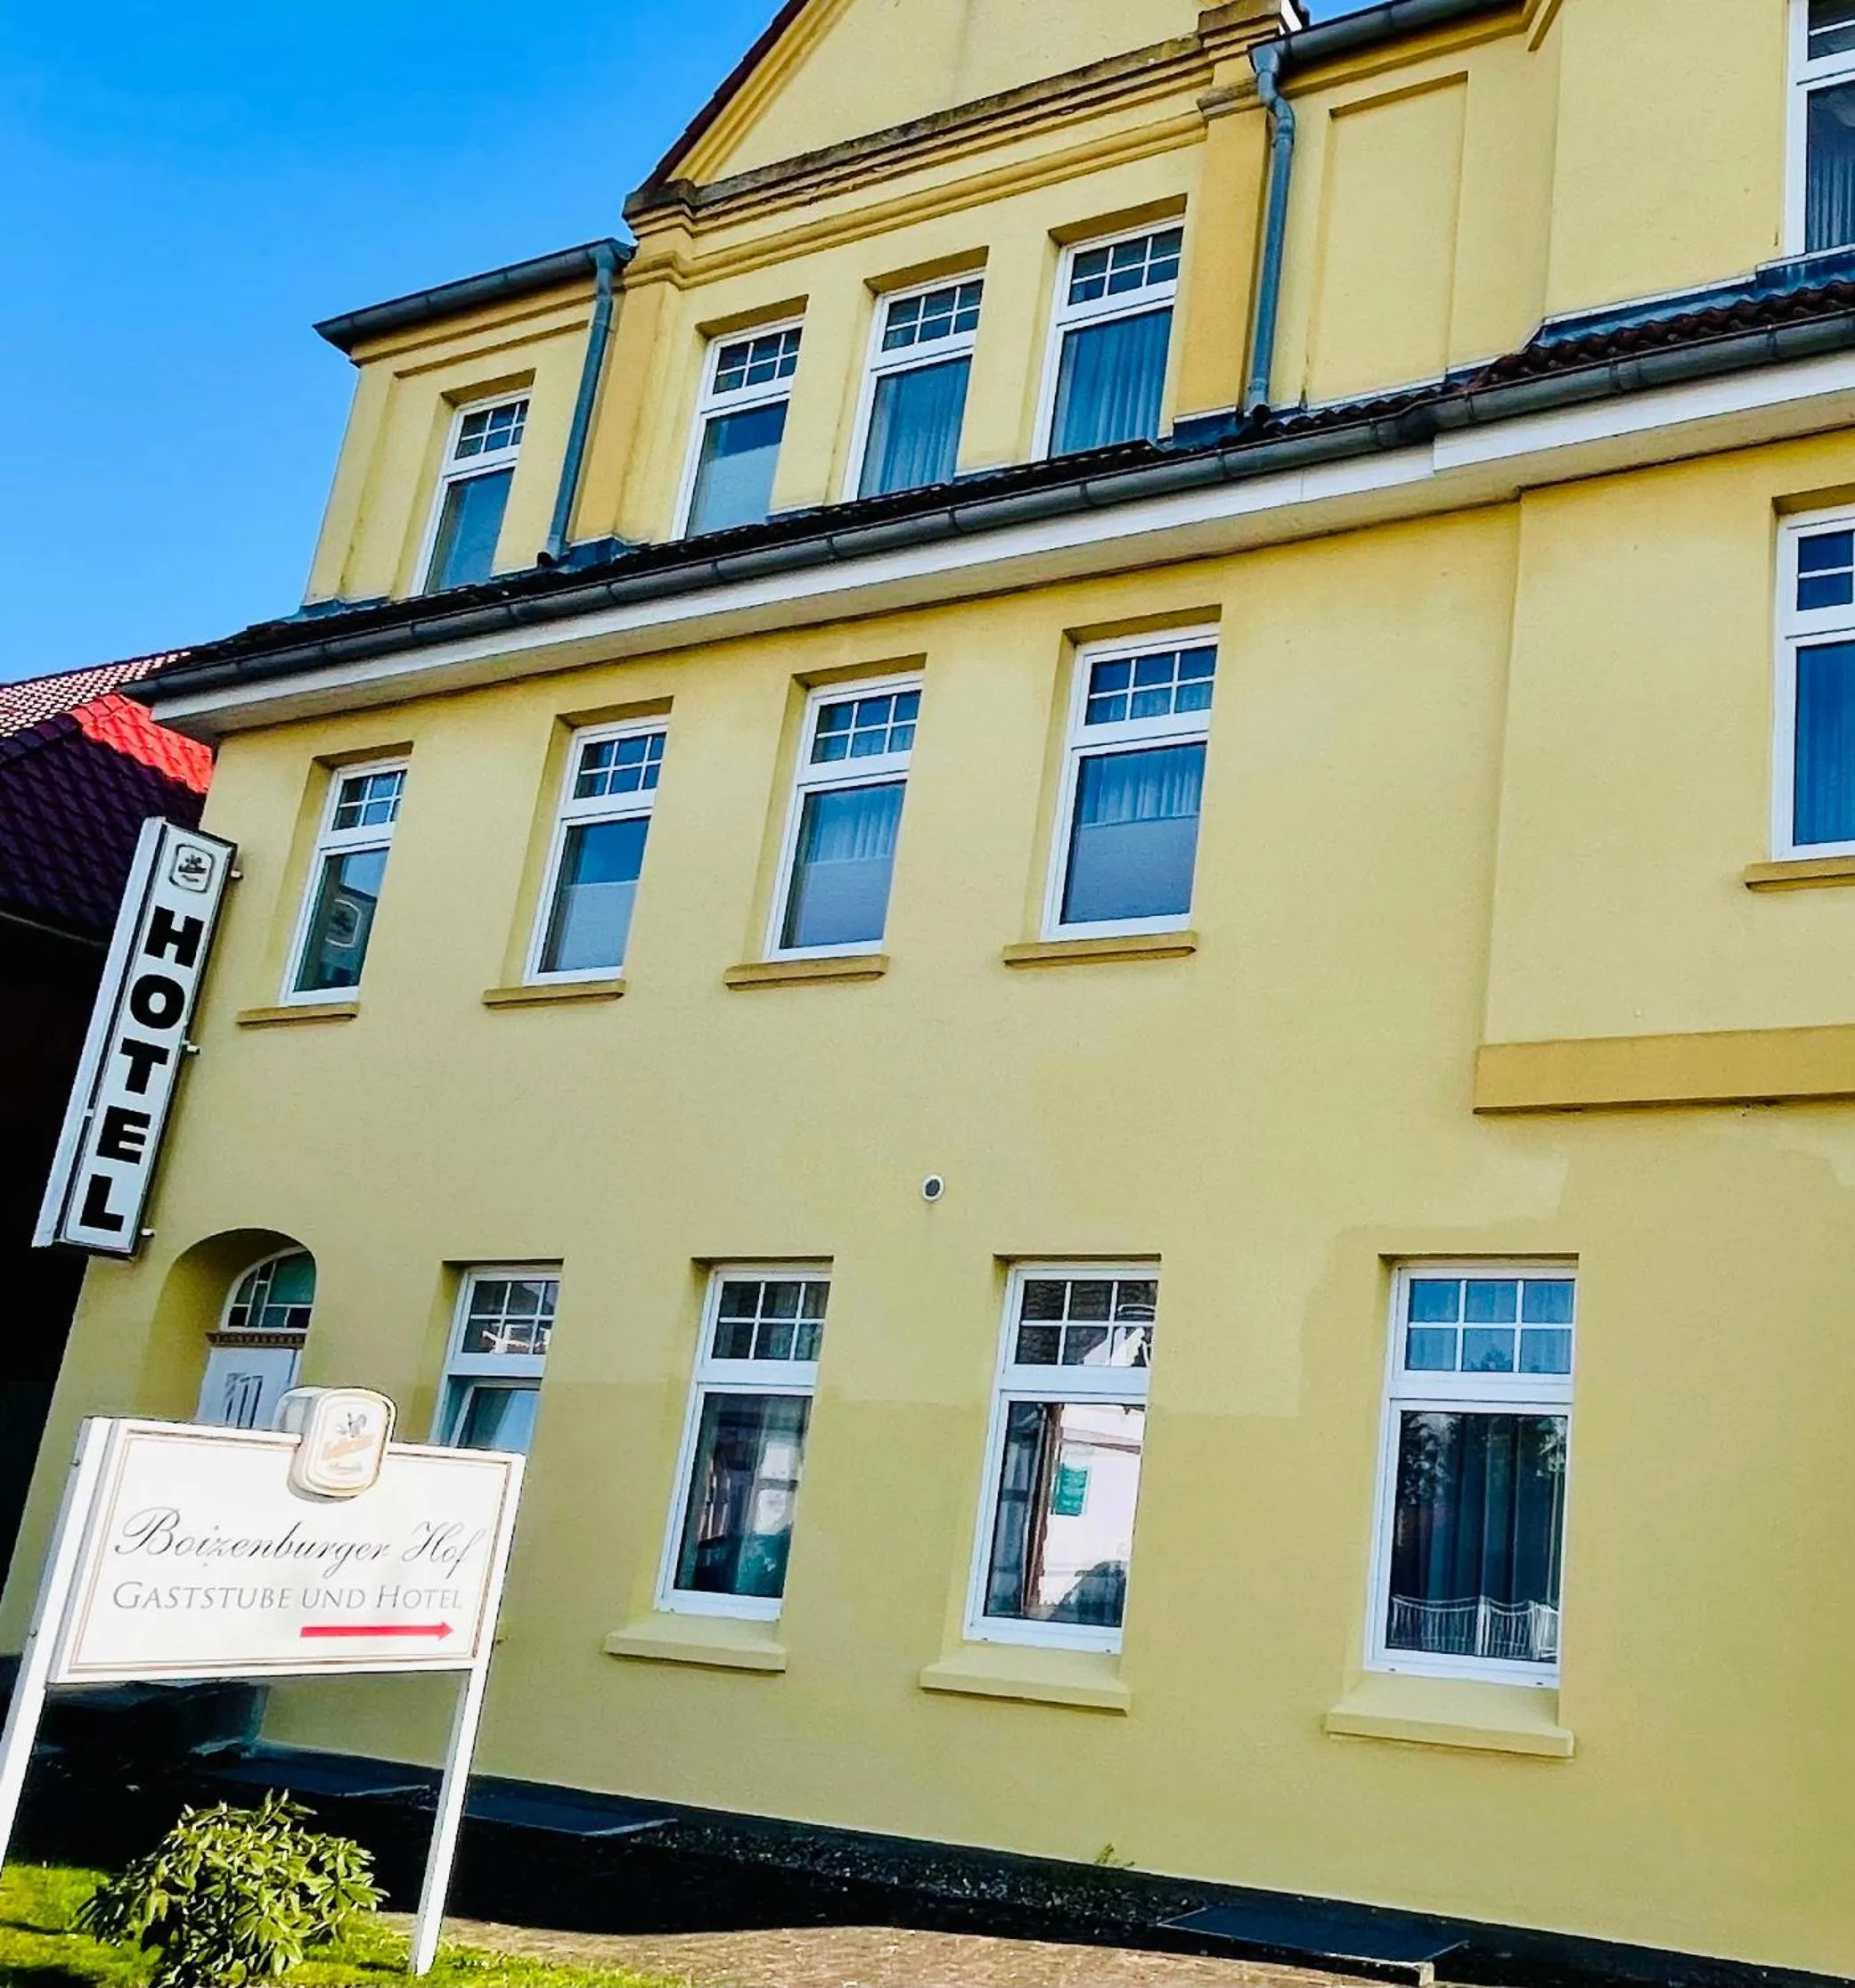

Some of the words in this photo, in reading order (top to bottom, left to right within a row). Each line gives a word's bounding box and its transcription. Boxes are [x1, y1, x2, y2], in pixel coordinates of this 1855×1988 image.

[79, 904, 204, 1232] HOTEL
[114, 1506, 389, 1579] Boizenburger
[402, 1520, 486, 1579] Hof
[113, 1581, 292, 1609] GASTSTUBE
[301, 1587, 366, 1609] UND
[372, 1584, 463, 1610] HOTEL
